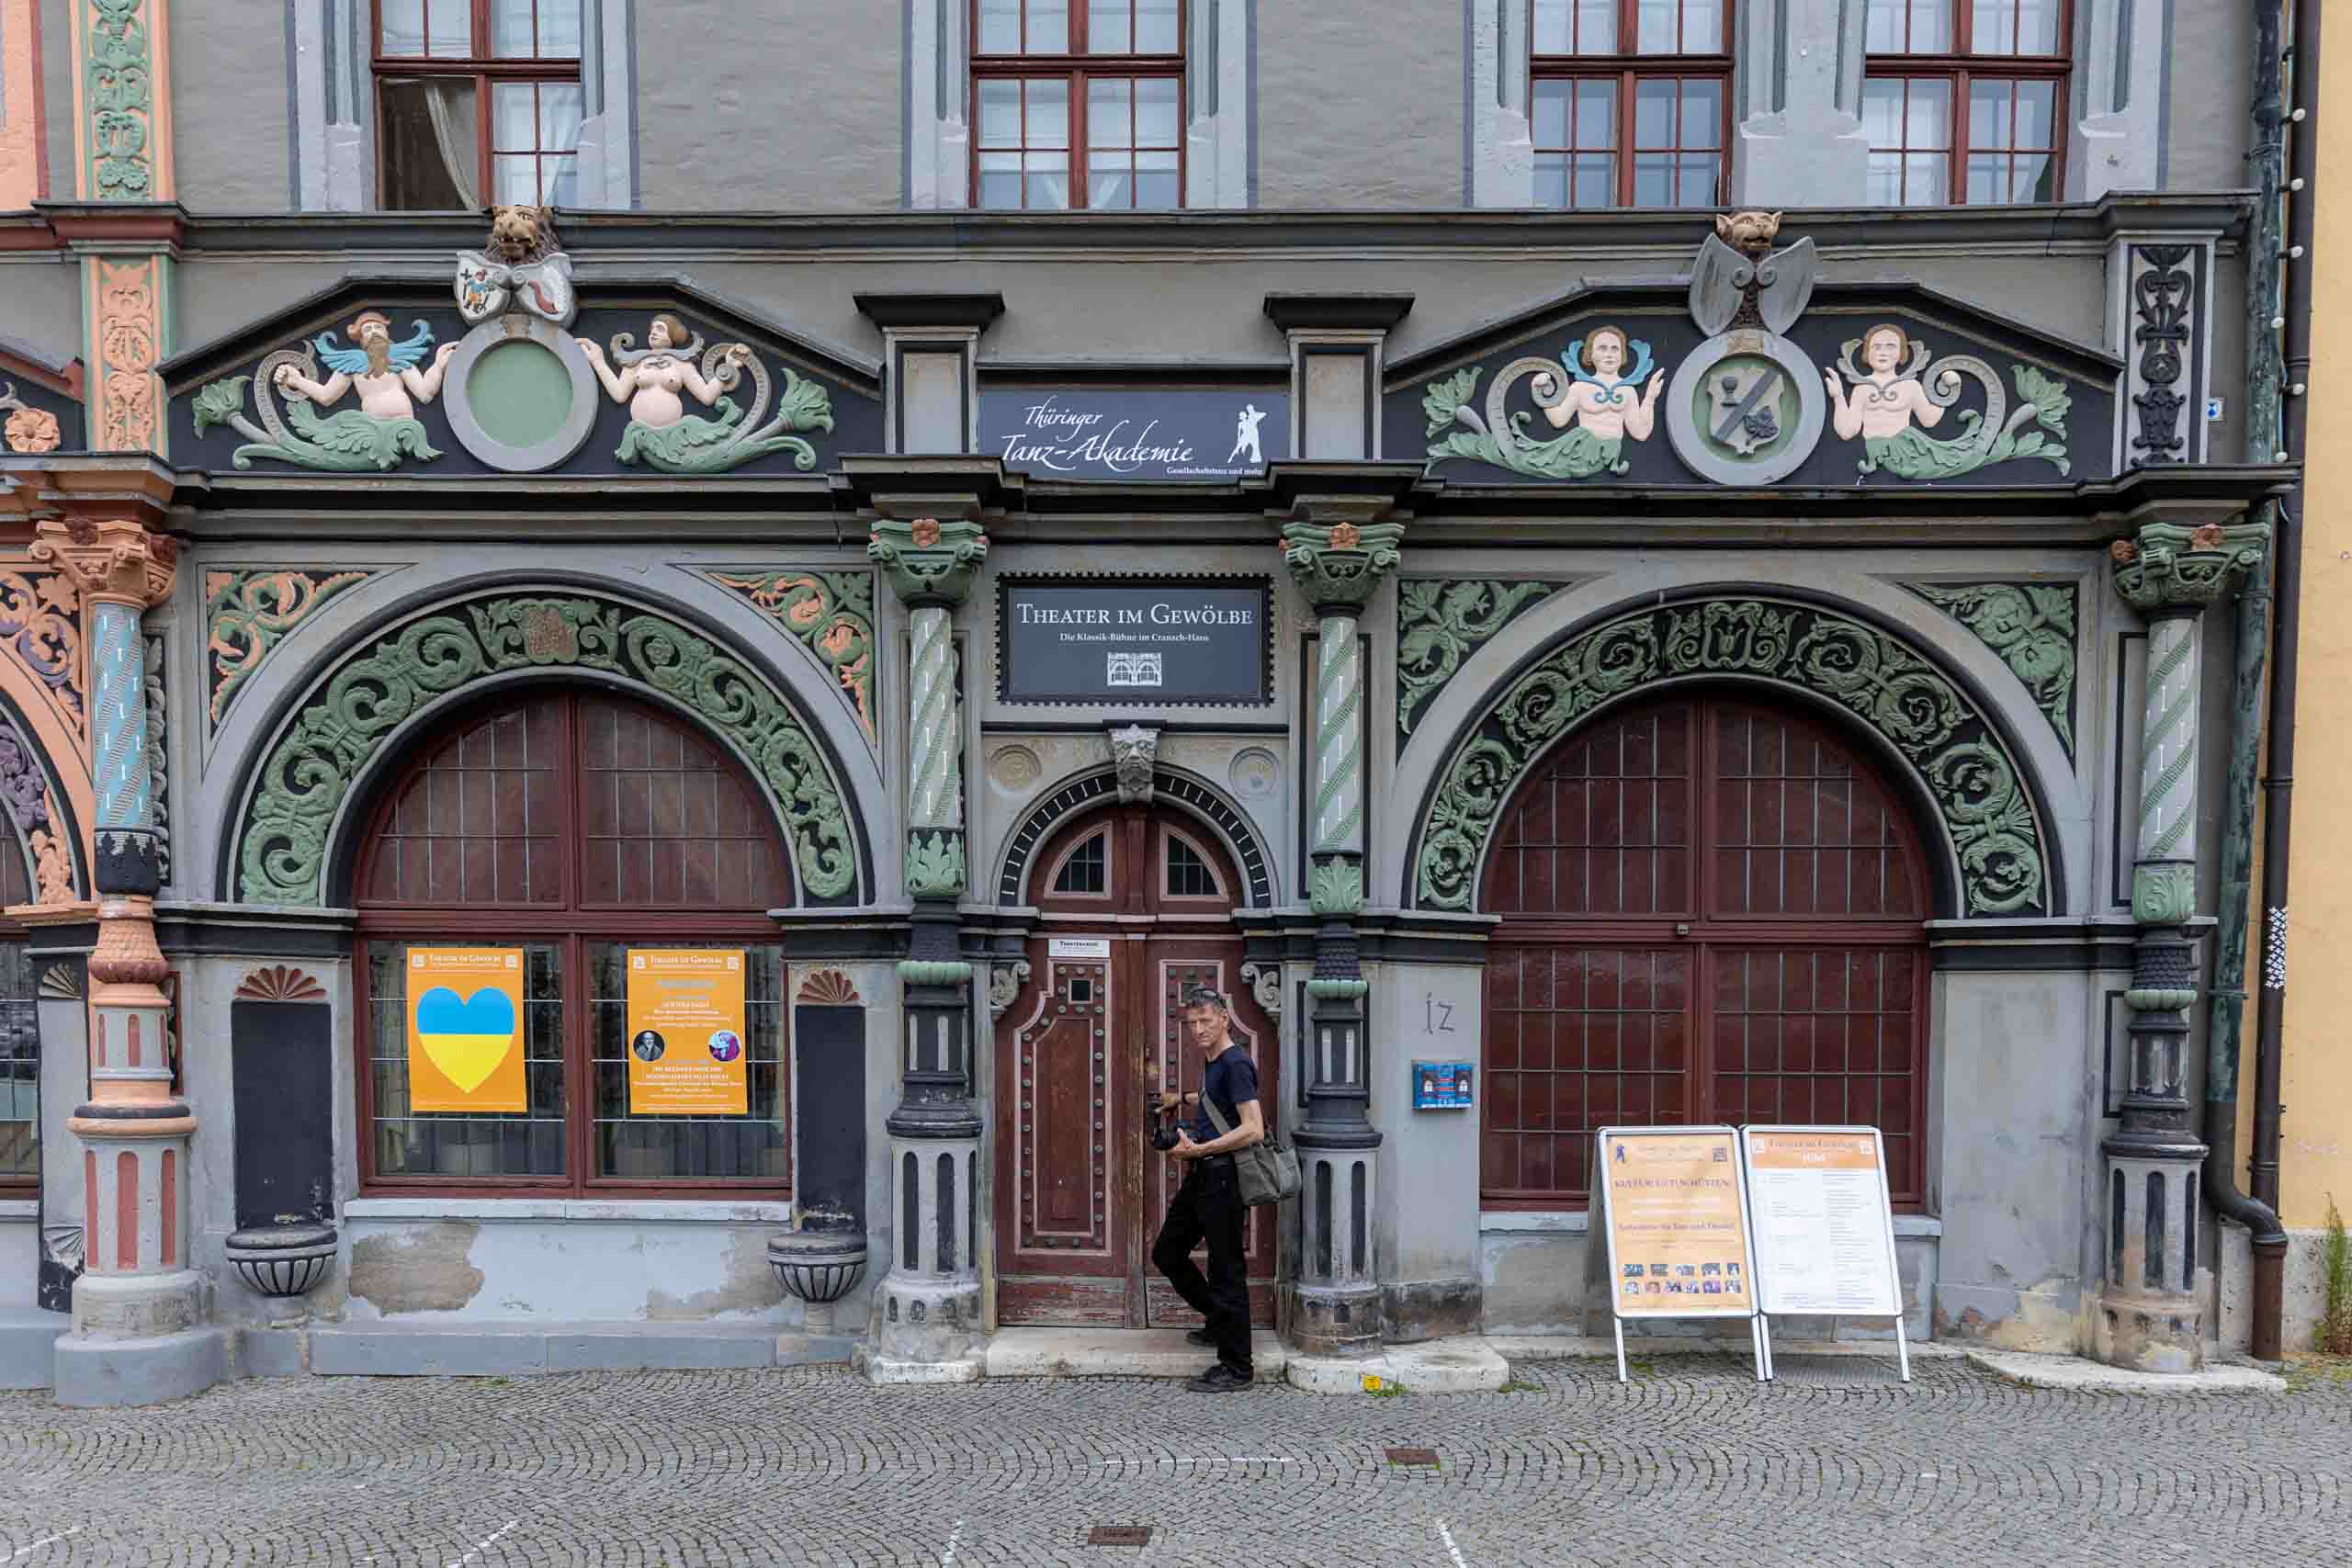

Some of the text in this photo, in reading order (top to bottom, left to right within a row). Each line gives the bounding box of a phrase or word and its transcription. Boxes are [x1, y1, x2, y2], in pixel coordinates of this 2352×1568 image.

[1024, 395, 1102, 442] Thüringer
[1001, 420, 1194, 471] Tanz-Akademie
[1016, 603, 1252, 625] THEATER IM GEWÖLBE
[1060, 632, 1075, 641] Die
[1077, 632, 1136, 641] Klassik-Bühne
[1138, 632, 1149, 640] im
